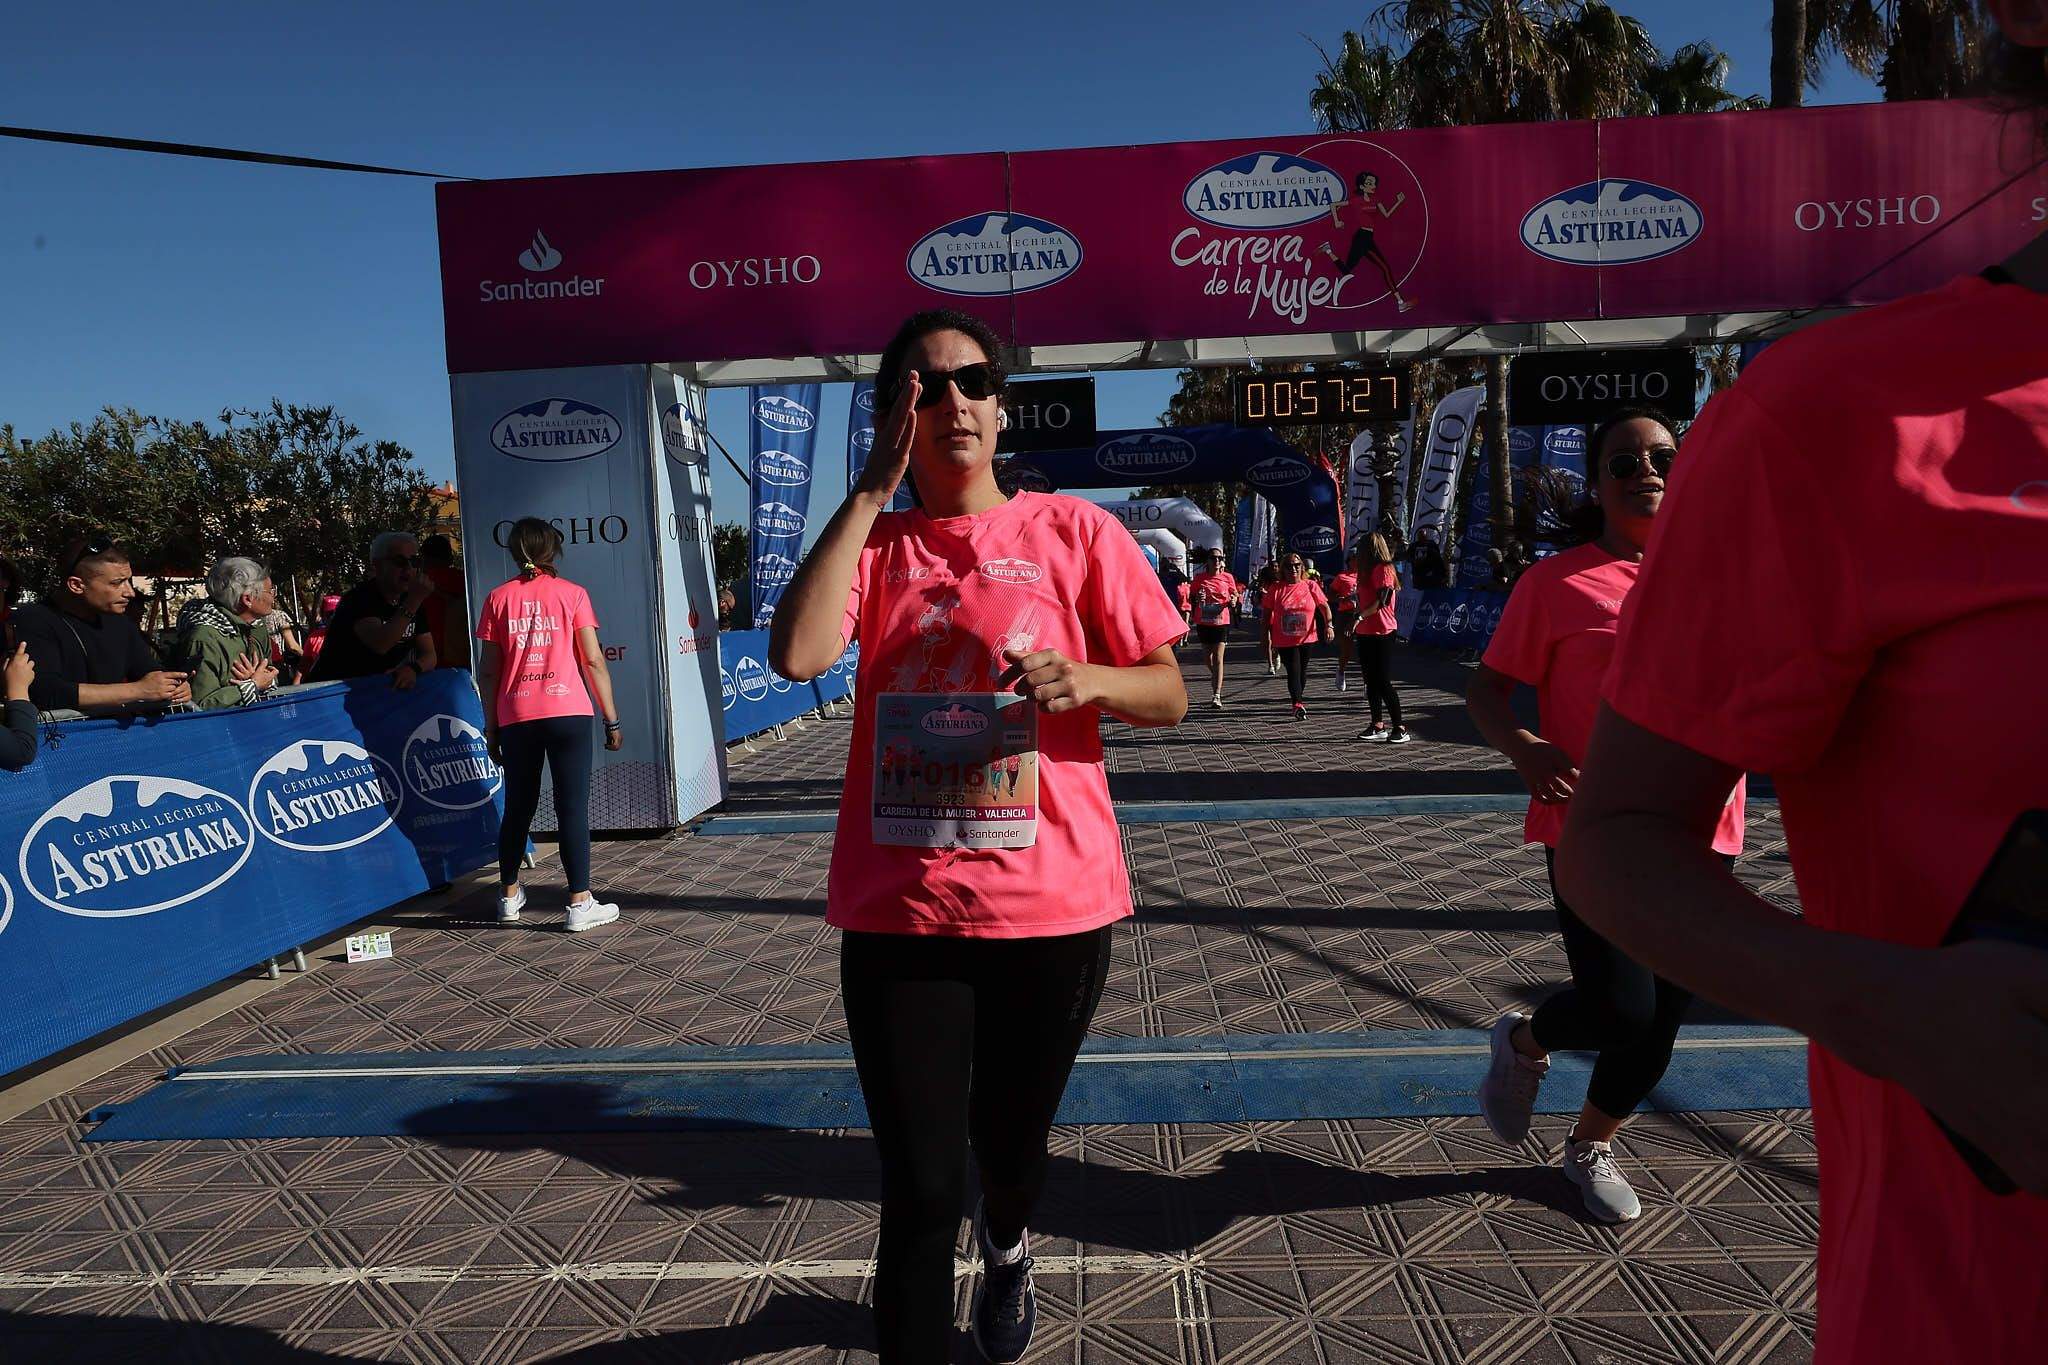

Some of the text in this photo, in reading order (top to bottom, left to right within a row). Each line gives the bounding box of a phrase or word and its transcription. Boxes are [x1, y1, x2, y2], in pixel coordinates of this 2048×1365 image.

[1220, 175, 1329, 188] CENTRAL LECHERA
[1196, 183, 1333, 211] ASTURIANA
[1562, 205, 1683, 219] CENTRAL LECHERA
[1794, 194, 1941, 231] OYSHO
[1534, 213, 1689, 245] ASTURIANA
[946, 238, 1063, 251] CENTRAL ECHERA
[1170, 227, 1304, 266] Carrera
[688, 255, 822, 289] OYSHO
[921, 246, 1070, 277] ASTURIANA
[480, 275, 605, 302] Santander
[1204, 259, 1355, 325] de la Mujer
[1247, 376, 1397, 418] 00:57:27
[1540, 371, 1669, 402] OYSHO
[519, 420, 561, 428] CENTRAL
[758, 403, 809, 428] ASTURIANA
[501, 423, 613, 448] ASTURIANA
[1103, 450, 1190, 467] ASTURIANA
[756, 460, 806, 481] ASTURIANA
[493, 515, 628, 548] OSHO
[669, 513, 709, 543] OYSHO
[986, 564, 1037, 578] ASTURANA
[523, 600, 541, 616] TU
[516, 634, 552, 650] SMA
[679, 633, 711, 655] Santander
[526, 652, 544, 661] 2024
[925, 716, 984, 729] ASTURIANA
[424, 747, 458, 760] CENTRAL
[282, 774, 333, 795] CENTRAL
[414, 754, 499, 793] ASTURIANA
[266, 775, 398, 835] ASTURIANA
[935, 793, 965, 805] 3923
[72, 800, 224, 847] CENTRAL LECHERA
[880, 806, 1027, 819] CARRERA DE LA MUJER VALENCIA
[888, 824, 936, 838] OYSHO
[969, 829, 1020, 839] Santander
[48, 817, 246, 900] ASTURIANA
